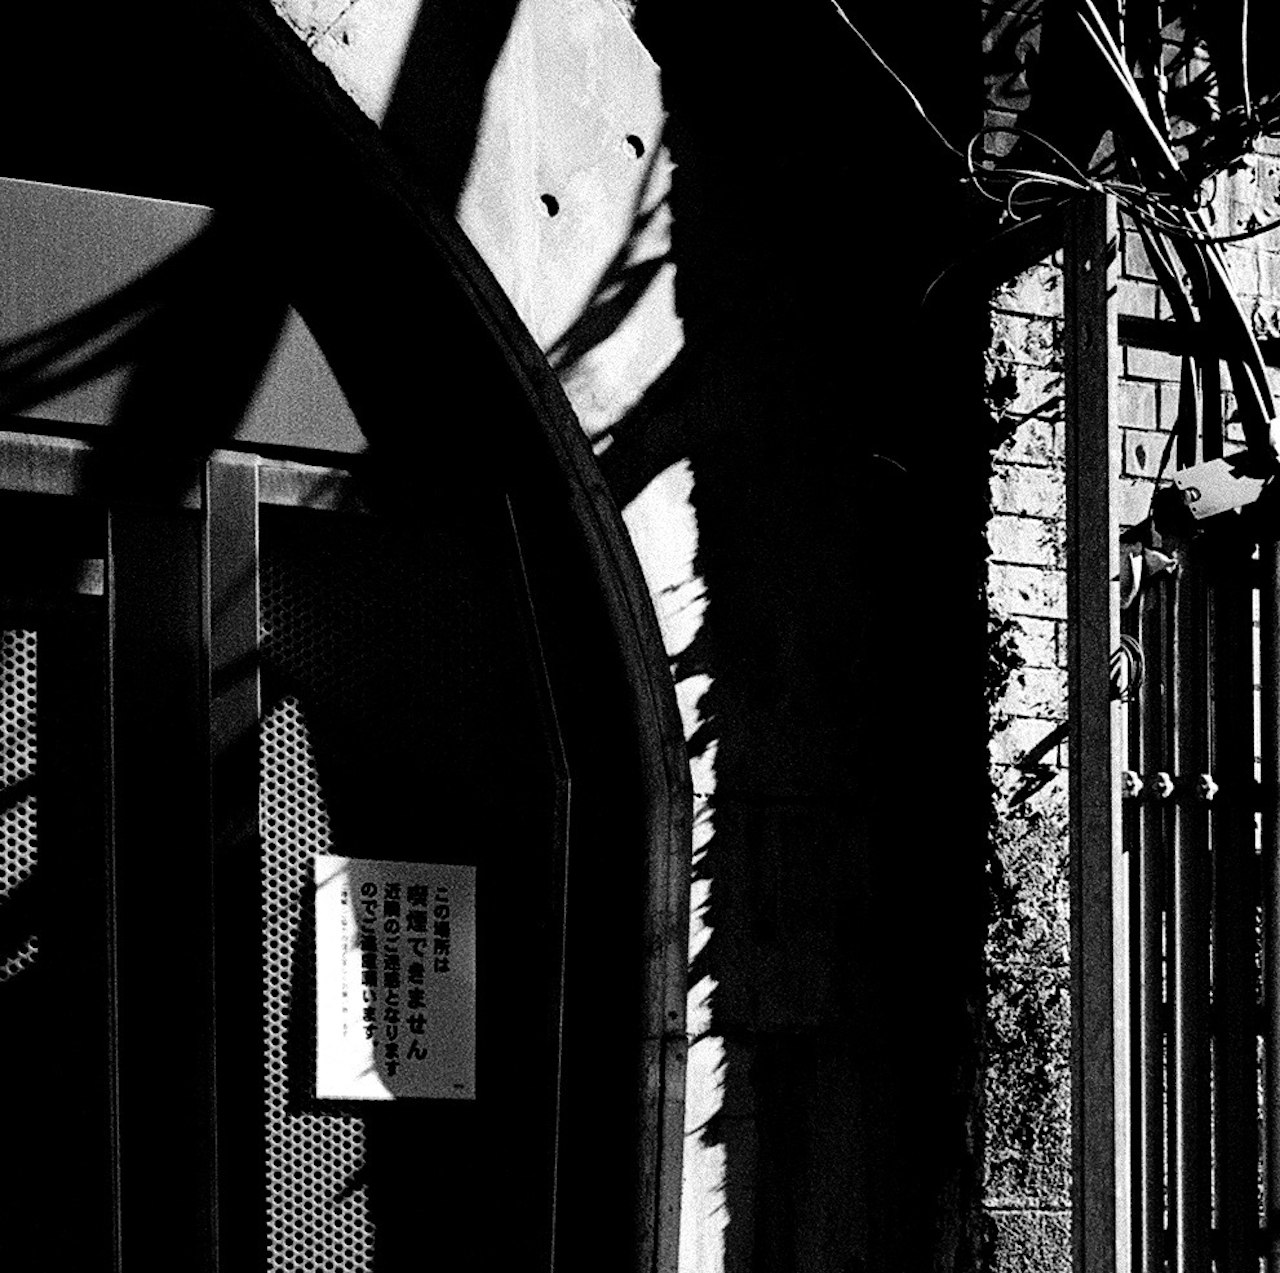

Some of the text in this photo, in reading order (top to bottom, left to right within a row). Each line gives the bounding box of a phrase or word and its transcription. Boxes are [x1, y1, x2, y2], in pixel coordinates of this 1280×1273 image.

[405, 883, 428, 1062] 喫煙できません
[433, 886, 451, 974] この場所は
